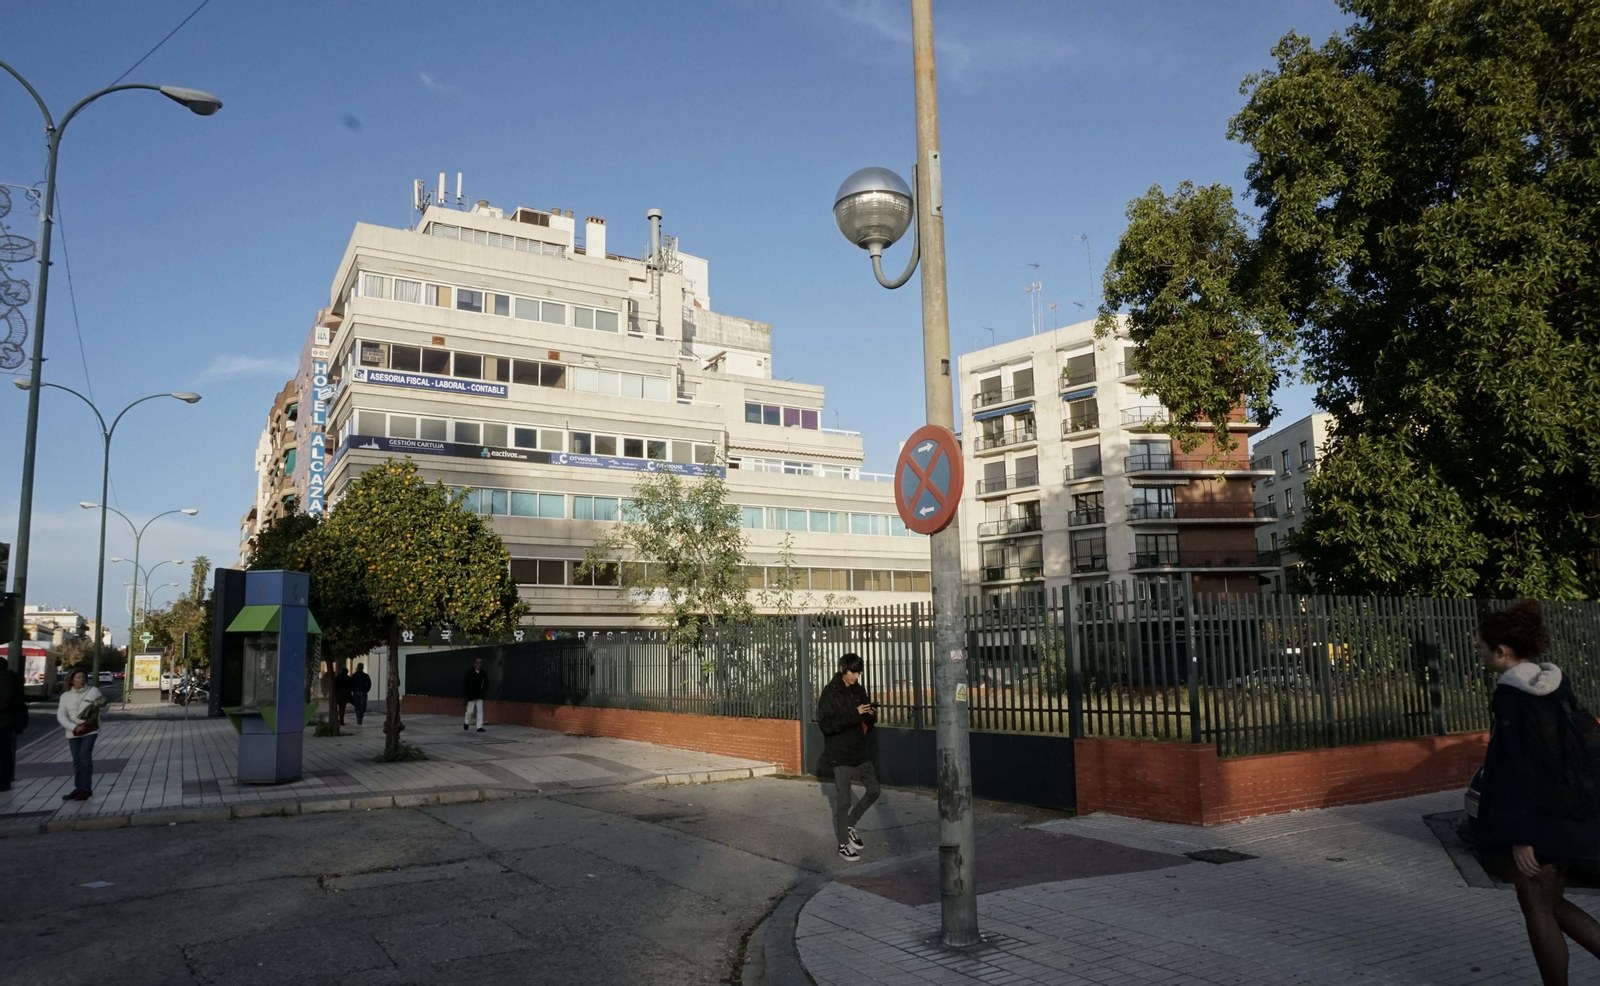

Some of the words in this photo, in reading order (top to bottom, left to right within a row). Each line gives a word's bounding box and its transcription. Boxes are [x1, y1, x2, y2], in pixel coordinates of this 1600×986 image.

[314, 363, 328, 424] HOTEL
[370, 373, 405, 383] ASESORIA
[406, 377, 430, 386] FISCAL
[435, 380, 466, 390] LABORAL
[471, 384, 505, 394] CONTABLE
[491, 450, 527, 459] eactivos.com
[309, 435, 324, 519] ALCAZA
